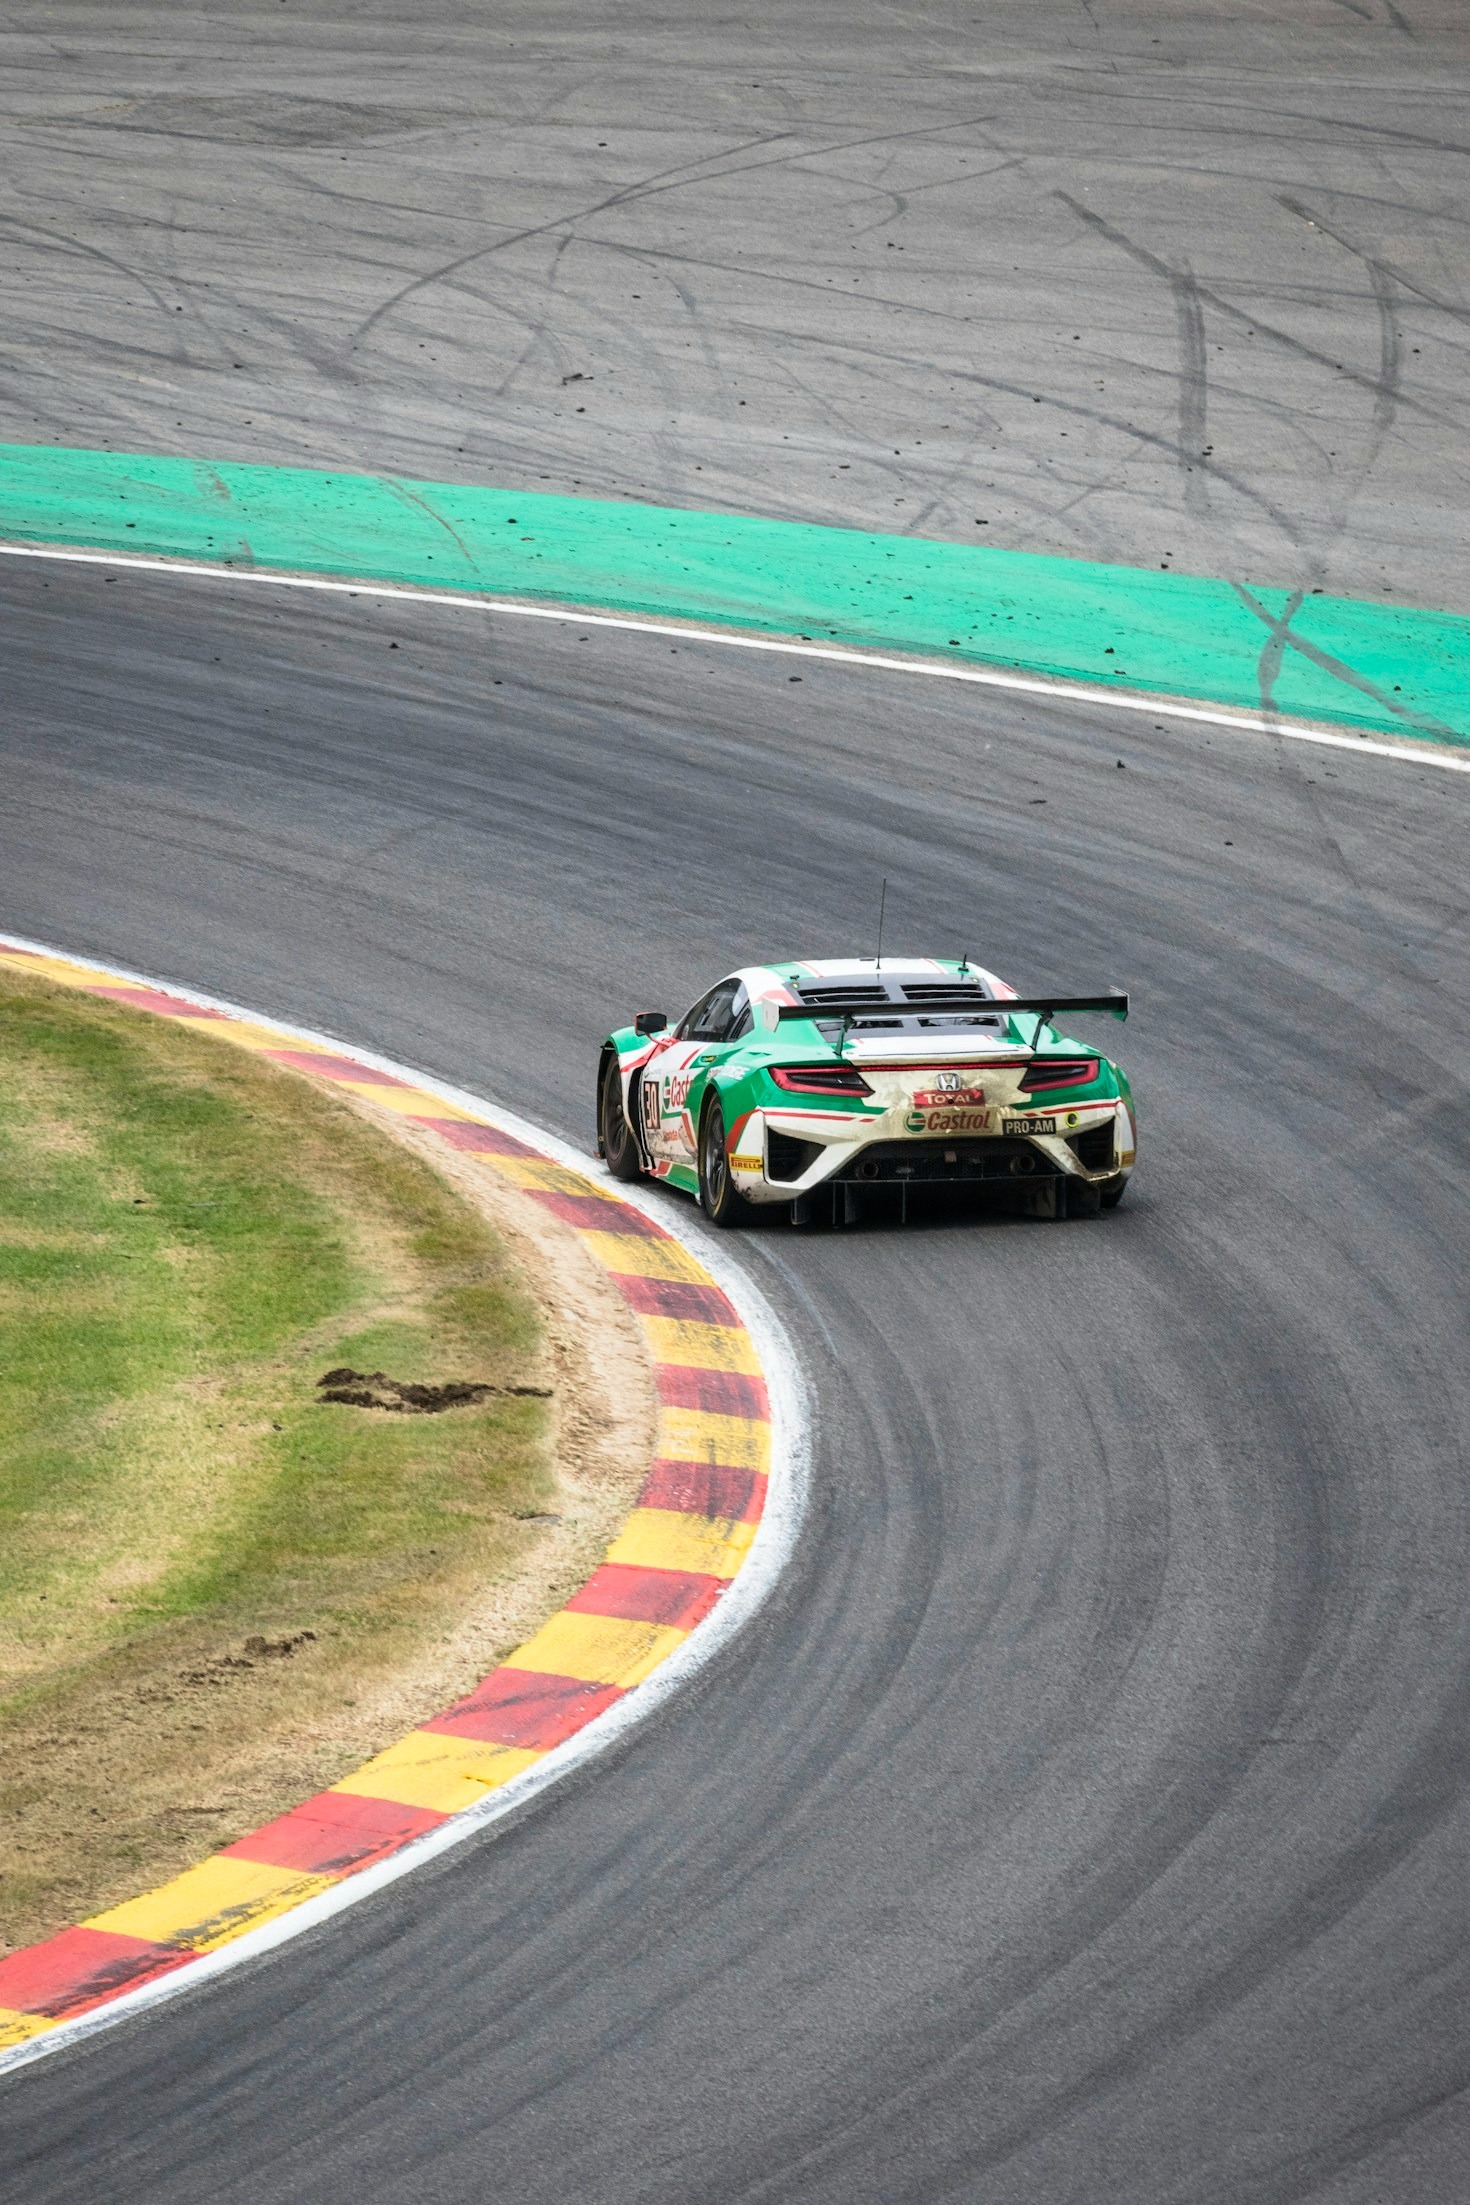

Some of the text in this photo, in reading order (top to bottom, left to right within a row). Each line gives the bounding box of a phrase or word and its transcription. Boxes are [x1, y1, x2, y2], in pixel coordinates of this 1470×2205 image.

[644, 1083, 658, 1128] 30
[928, 1111, 991, 1130] Castrol
[1006, 1120, 1053, 1134] PRO-AM
